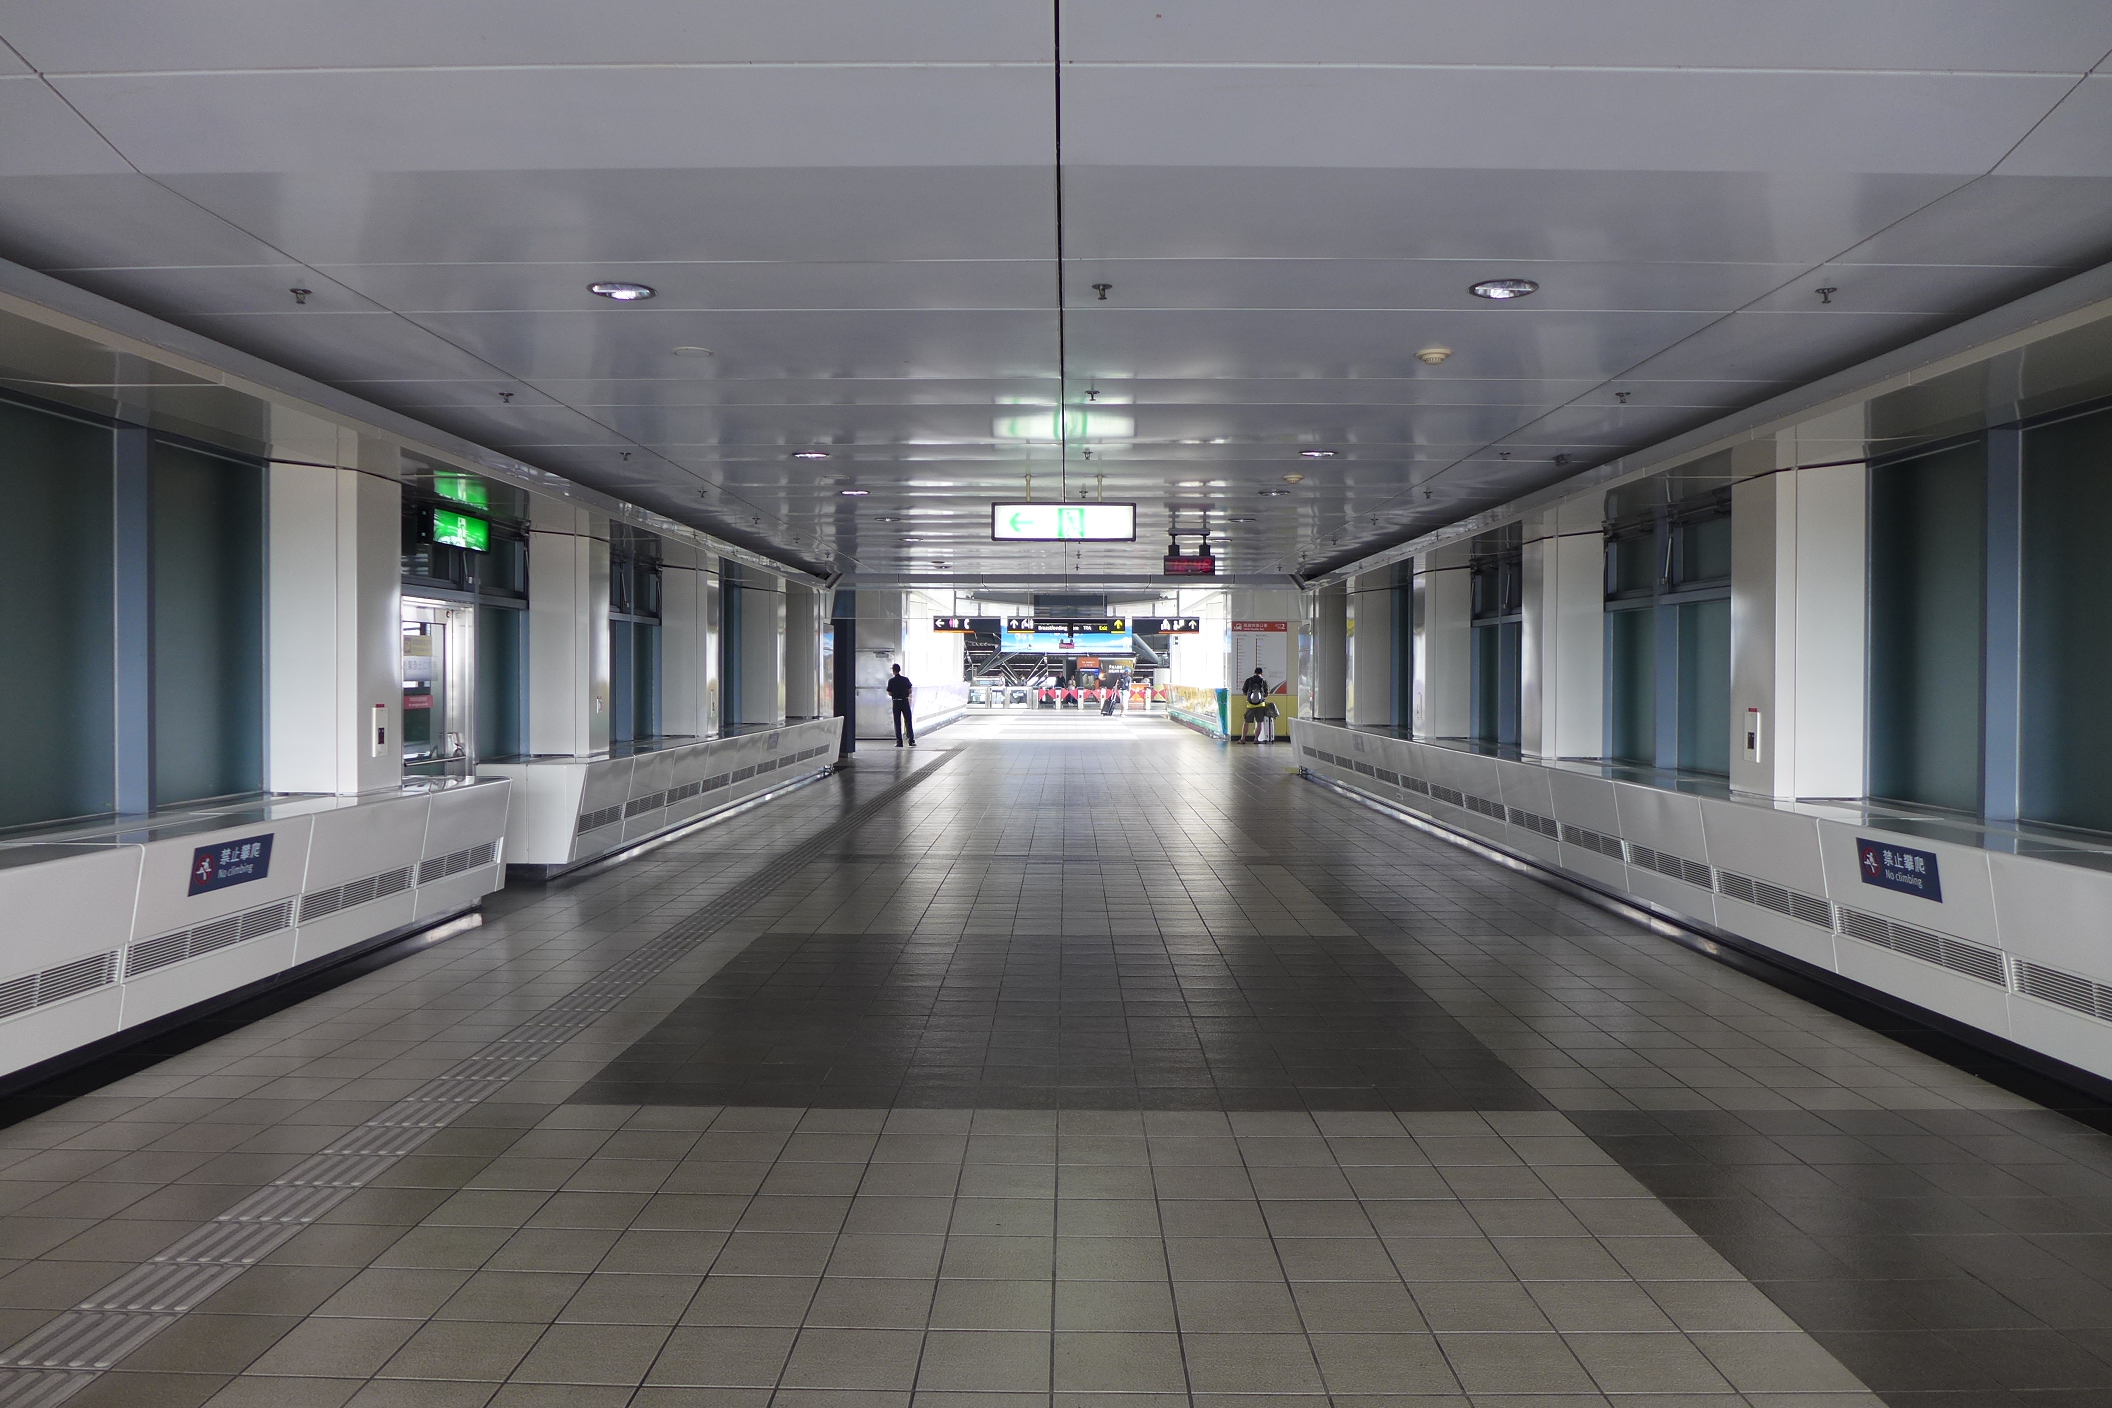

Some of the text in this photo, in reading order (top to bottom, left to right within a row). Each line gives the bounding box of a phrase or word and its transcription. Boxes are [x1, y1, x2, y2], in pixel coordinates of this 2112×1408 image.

[220, 842, 261, 865] 禁止攀爬
[1882, 849, 1926, 874] 禁止攀爬
[217, 863, 254, 879] No climbing
[1885, 868, 1923, 889] No climbing
